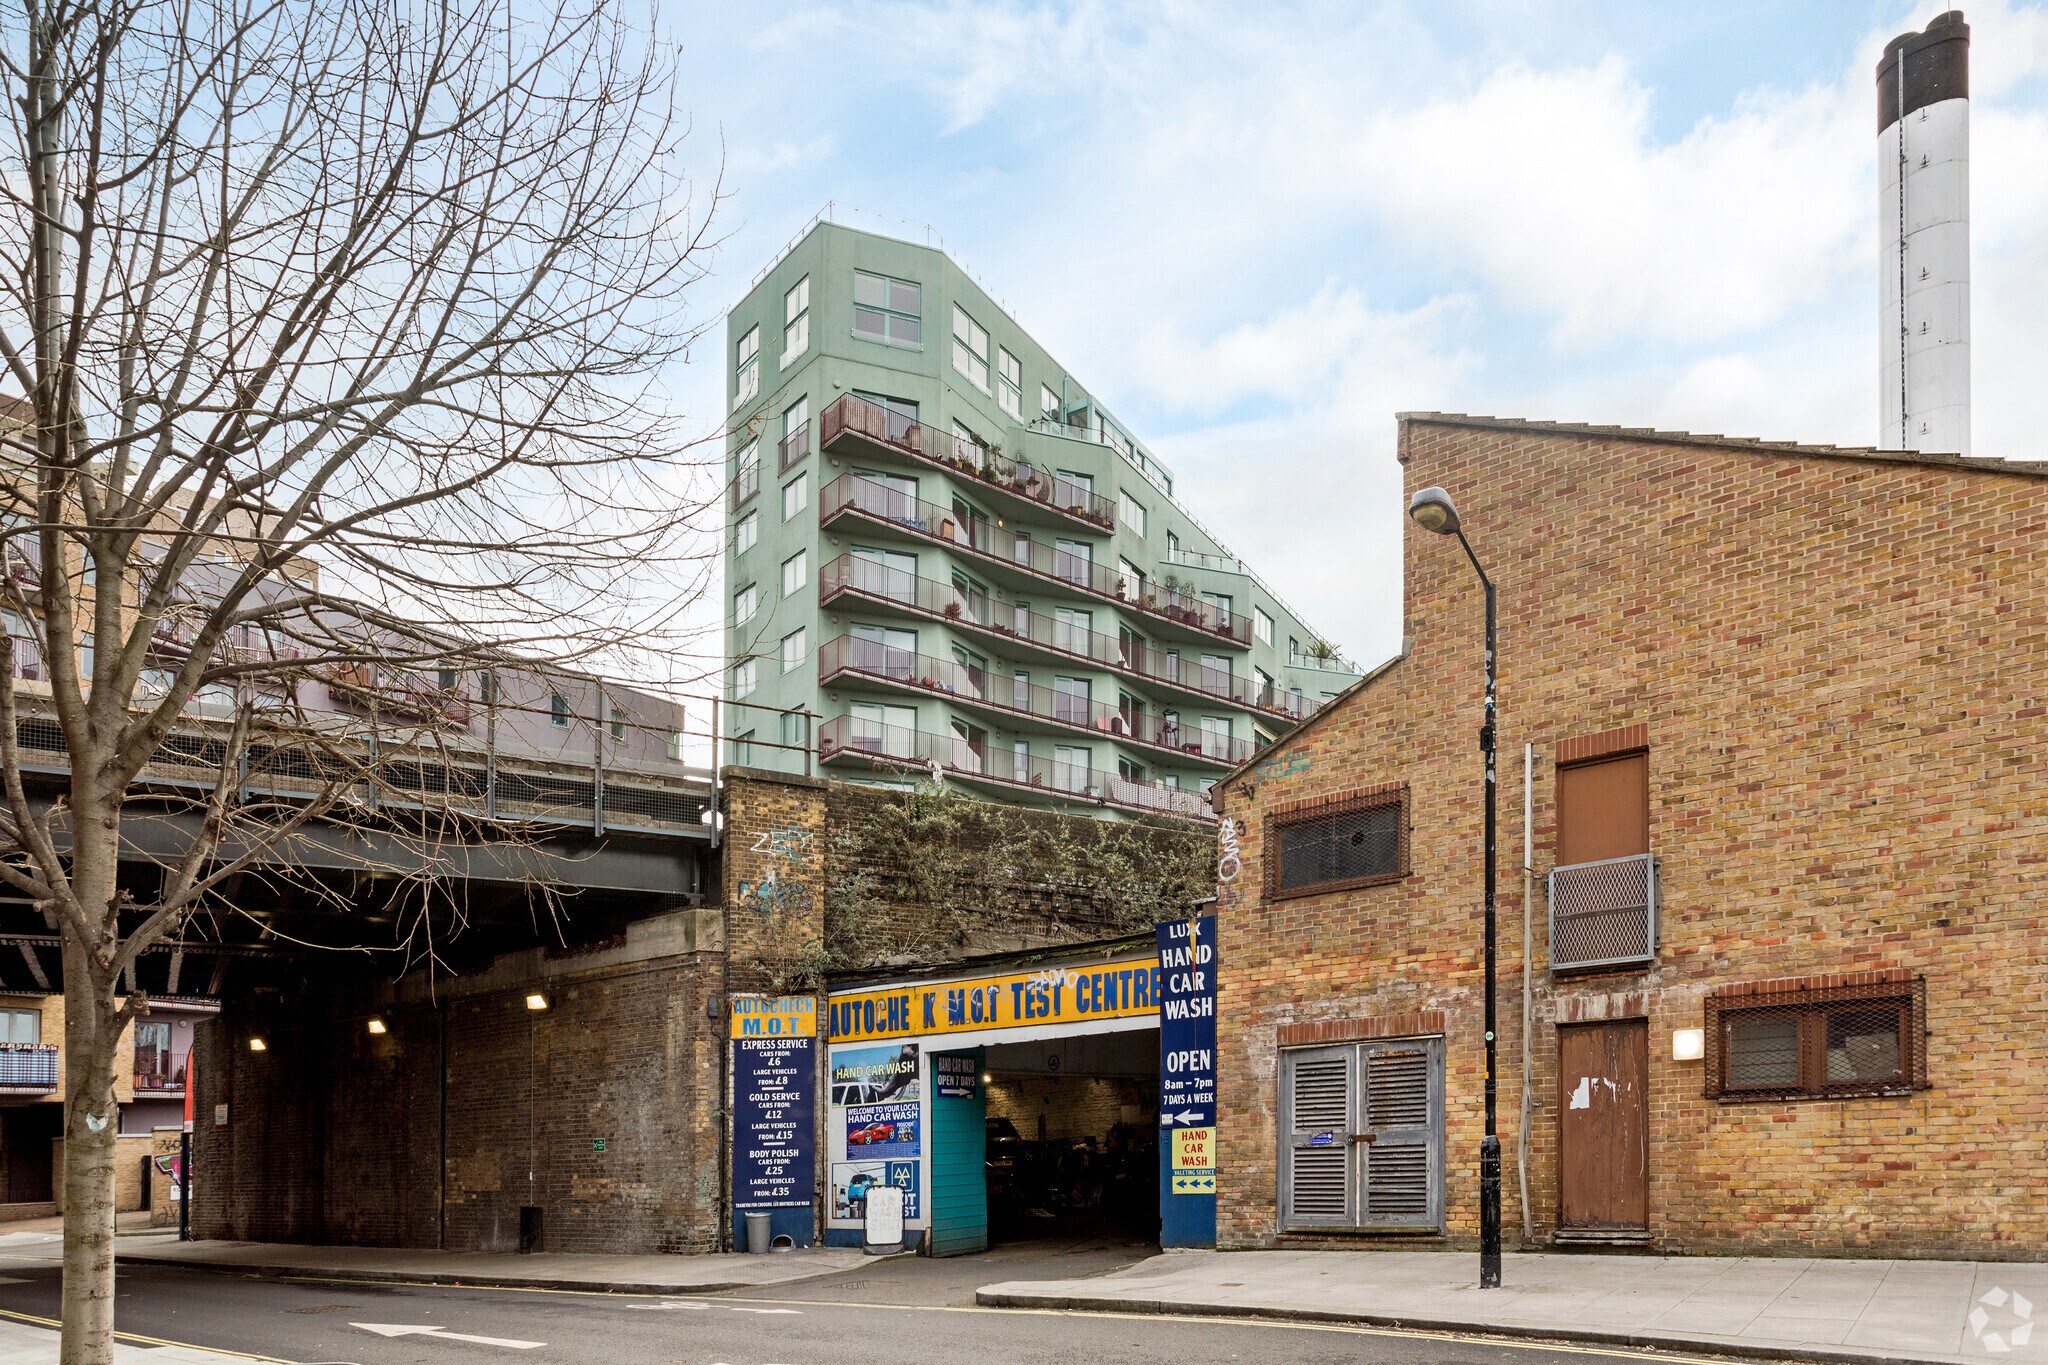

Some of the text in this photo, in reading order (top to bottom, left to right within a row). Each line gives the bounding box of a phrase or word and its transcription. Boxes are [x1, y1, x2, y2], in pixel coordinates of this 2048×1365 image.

[1162, 944, 1212, 968] HAND
[1170, 972, 1205, 993] CAR
[1011, 978, 1064, 1019] TEST
[1076, 966, 1160, 1013] CENTRE
[734, 996, 814, 1014] AUTOCHECK
[1165, 996, 1212, 1020] WASH
[742, 1017, 806, 1036] M.O.T.
[742, 1039, 808, 1050] EXPRESS SERVICE
[768, 1058, 781, 1066] £6
[1167, 1049, 1210, 1072] OPEN
[836, 1061, 914, 1079] HAND CAR WASH
[775, 1076, 788, 1085] £8
[938, 1074, 975, 1086] OPEN 7 DAYS
[1165, 1080, 1184, 1090] 8am
[1194, 1078, 1212, 1090] 7pm
[749, 1093, 770, 1101] GOLD
[1164, 1093, 1213, 1105] 7 DAYS A WEEK
[765, 1110, 782, 1119] £12
[848, 1106, 875, 1115] WELCOME
[848, 1111, 918, 1123] HAND CAR WASH
[776, 1131, 793, 1140] £15
[1182, 1130, 1207, 1141] HAND
[749, 1149, 799, 1158] BODY POLISH
[1184, 1143, 1203, 1153] CAR
[1182, 1156, 1207, 1166] WASH
[765, 1166, 783, 1175] £25
[772, 1187, 789, 1196] £35
